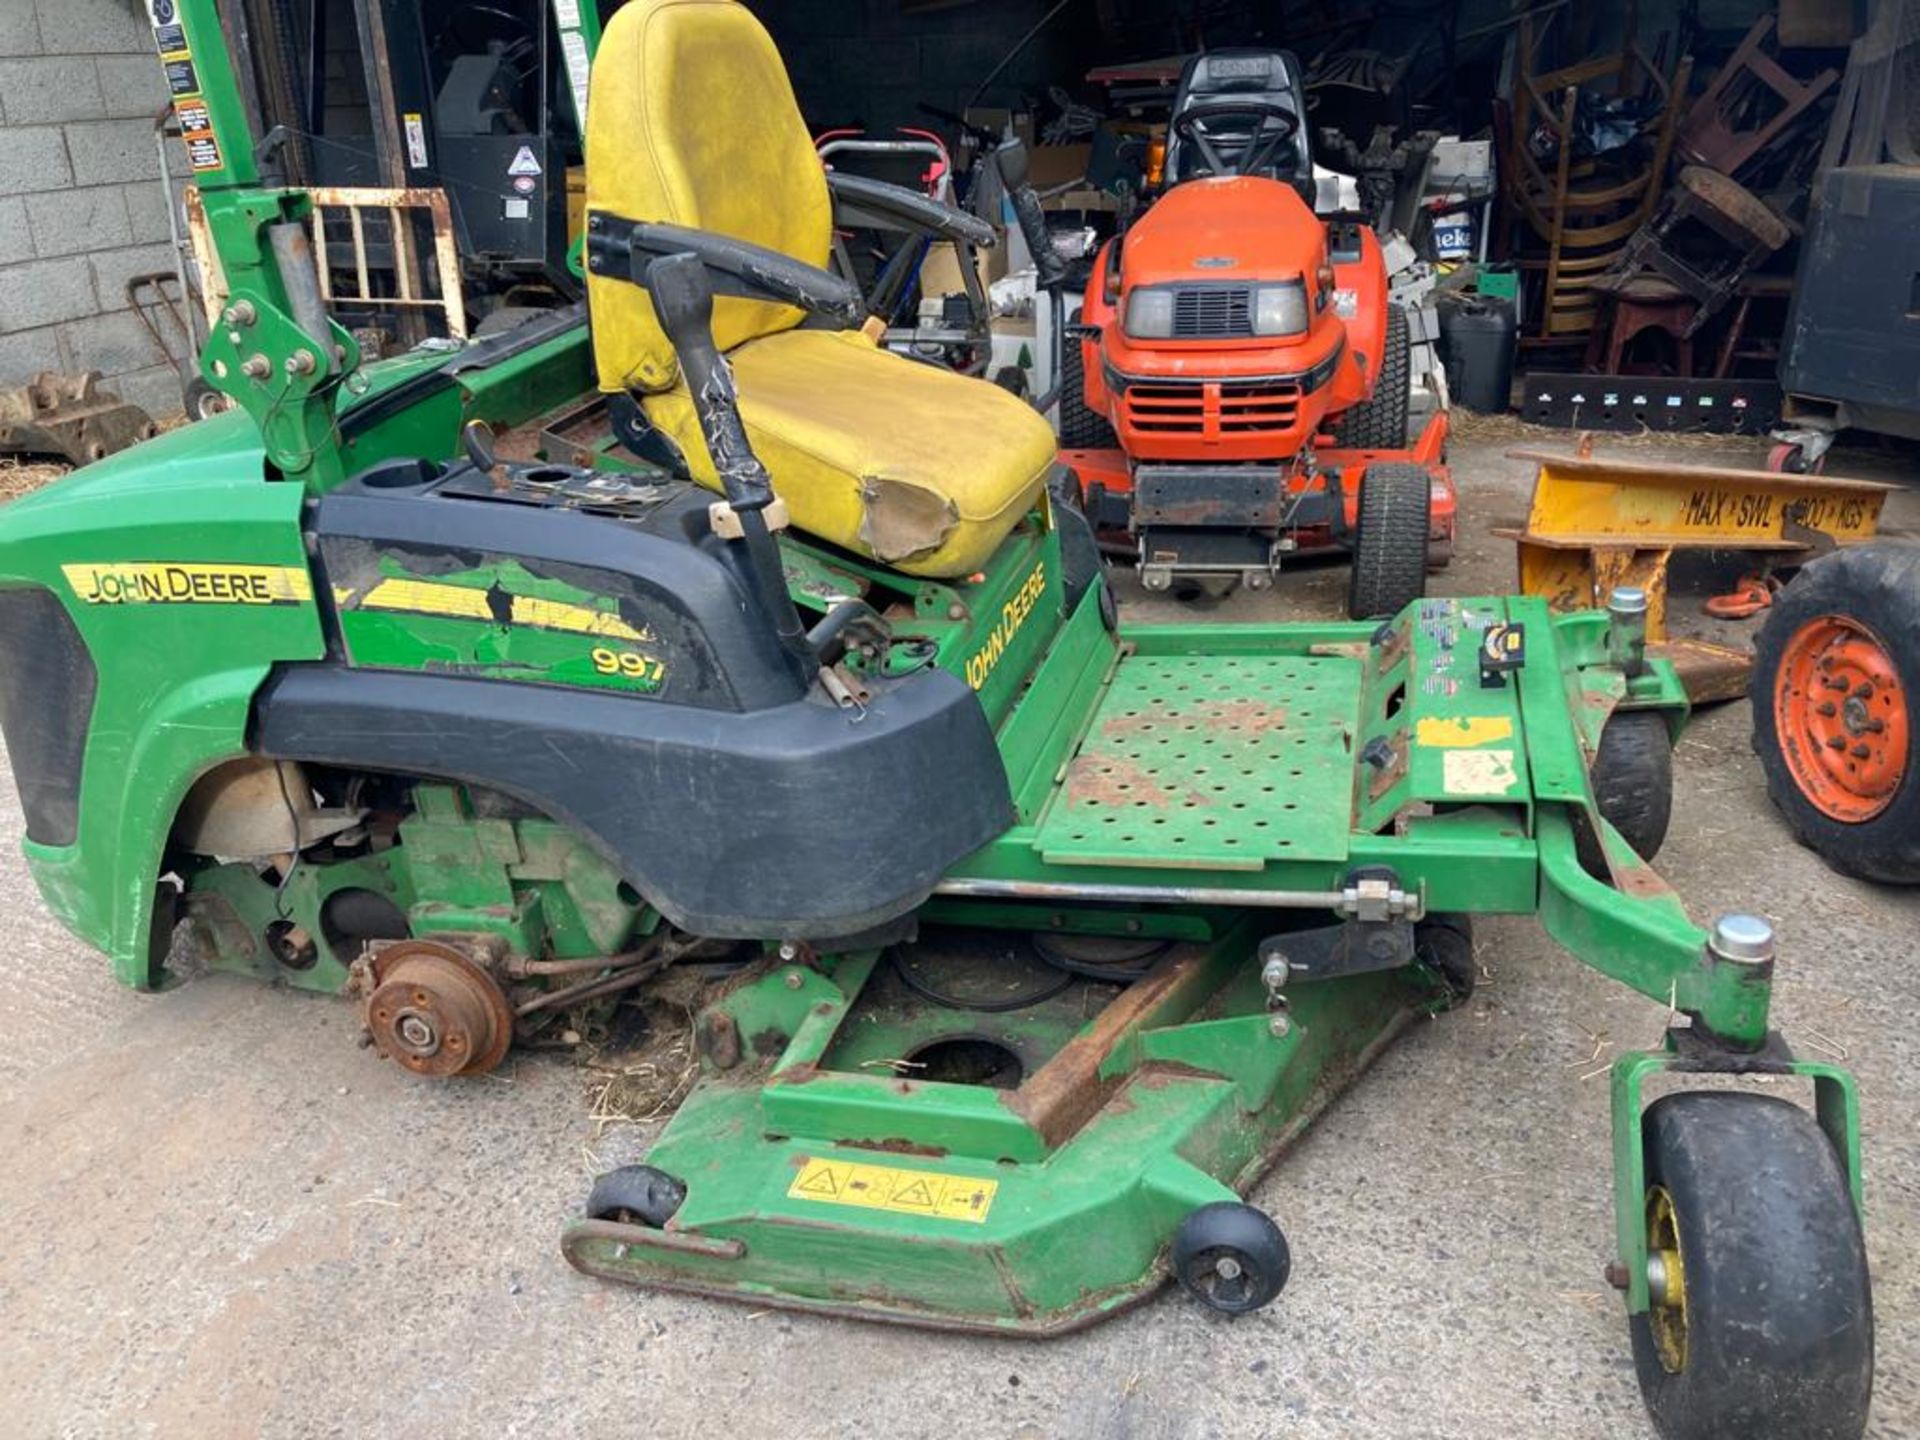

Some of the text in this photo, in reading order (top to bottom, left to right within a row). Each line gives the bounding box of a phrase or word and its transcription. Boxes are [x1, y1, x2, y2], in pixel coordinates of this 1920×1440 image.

[1684, 490, 1728, 526] MAX
[1736, 494, 1773, 528] SWL
[88, 567, 271, 599] JOHN DEERE
[965, 561, 1046, 691] JOHN DEERE
[592, 648, 666, 682] 997
